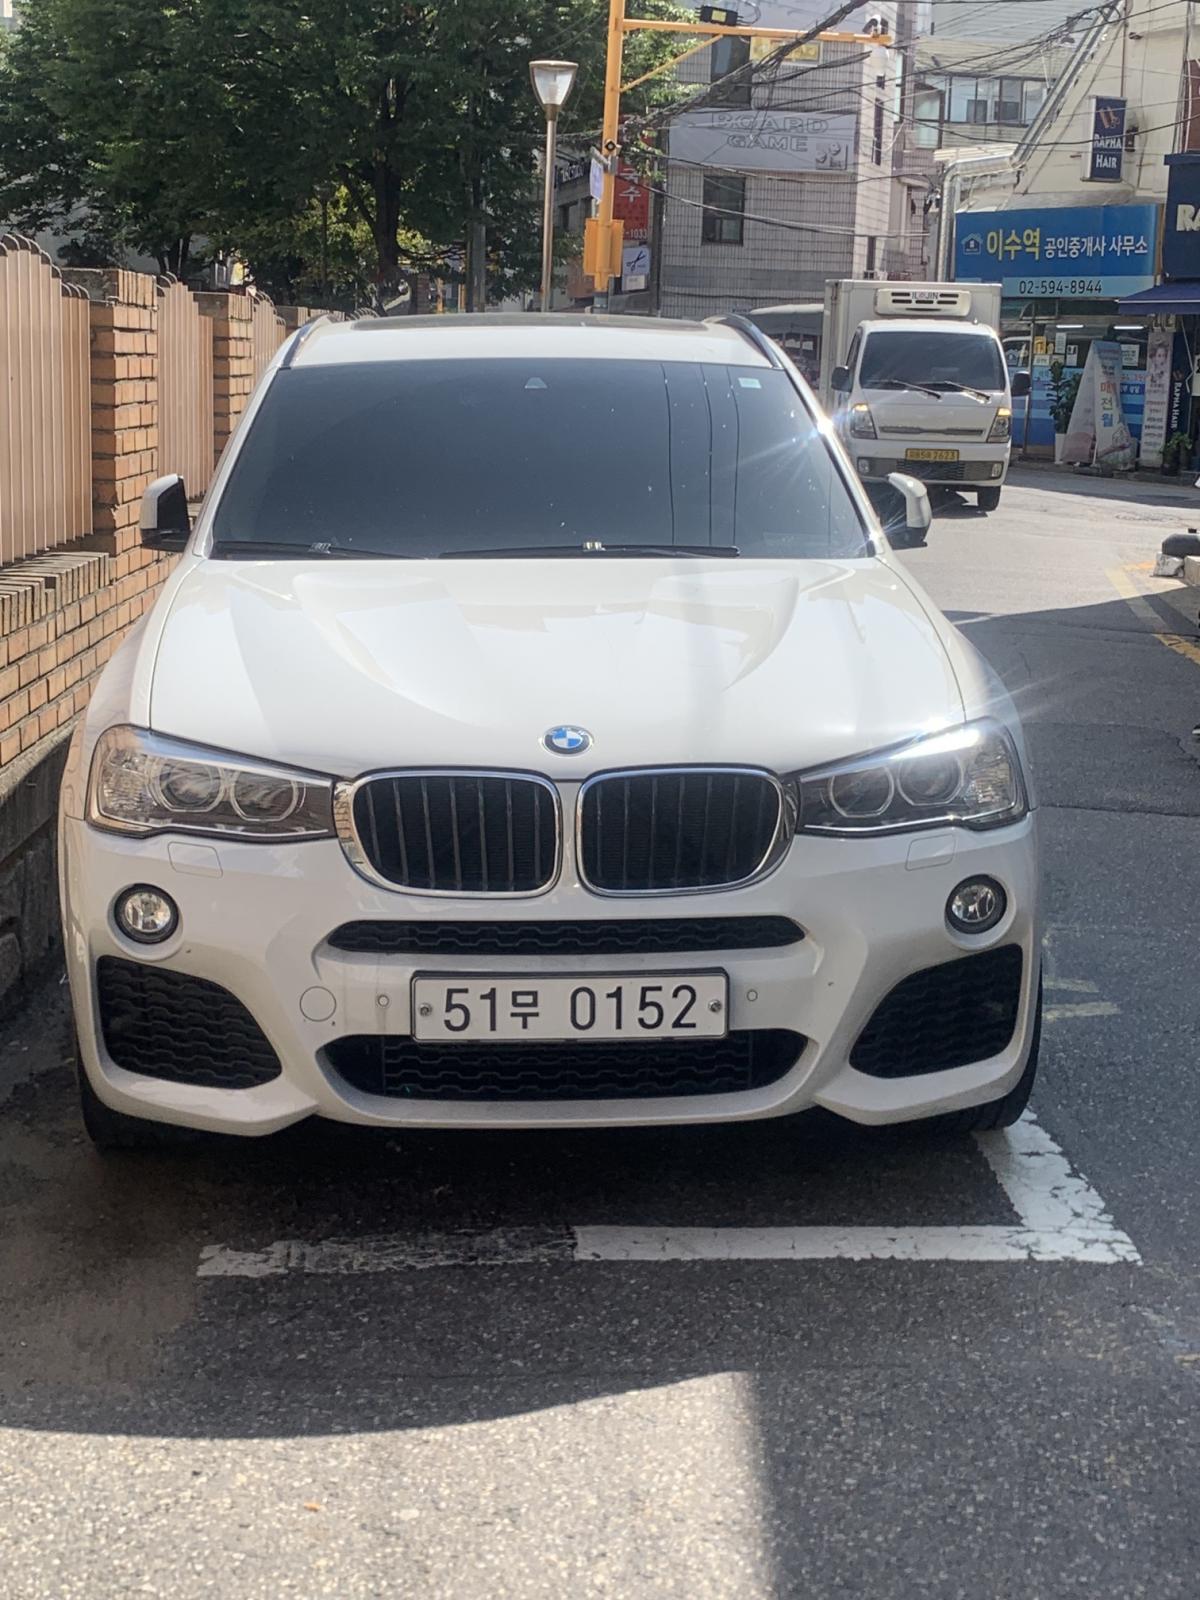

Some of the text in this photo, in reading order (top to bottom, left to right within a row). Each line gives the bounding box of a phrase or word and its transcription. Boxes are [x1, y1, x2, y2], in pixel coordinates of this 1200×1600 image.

[712, 112, 829, 134] BOARD
[726, 134, 808, 152] GAME
[1093, 133, 1122, 149] RAPHA
[1095, 154, 1118, 169] HAIR
[986, 227, 1149, 262] 이수역 공인중개사 사무소
[1019, 279, 1103, 295] 02-594-8944
[443, 984, 698, 1033] 51무 0152
